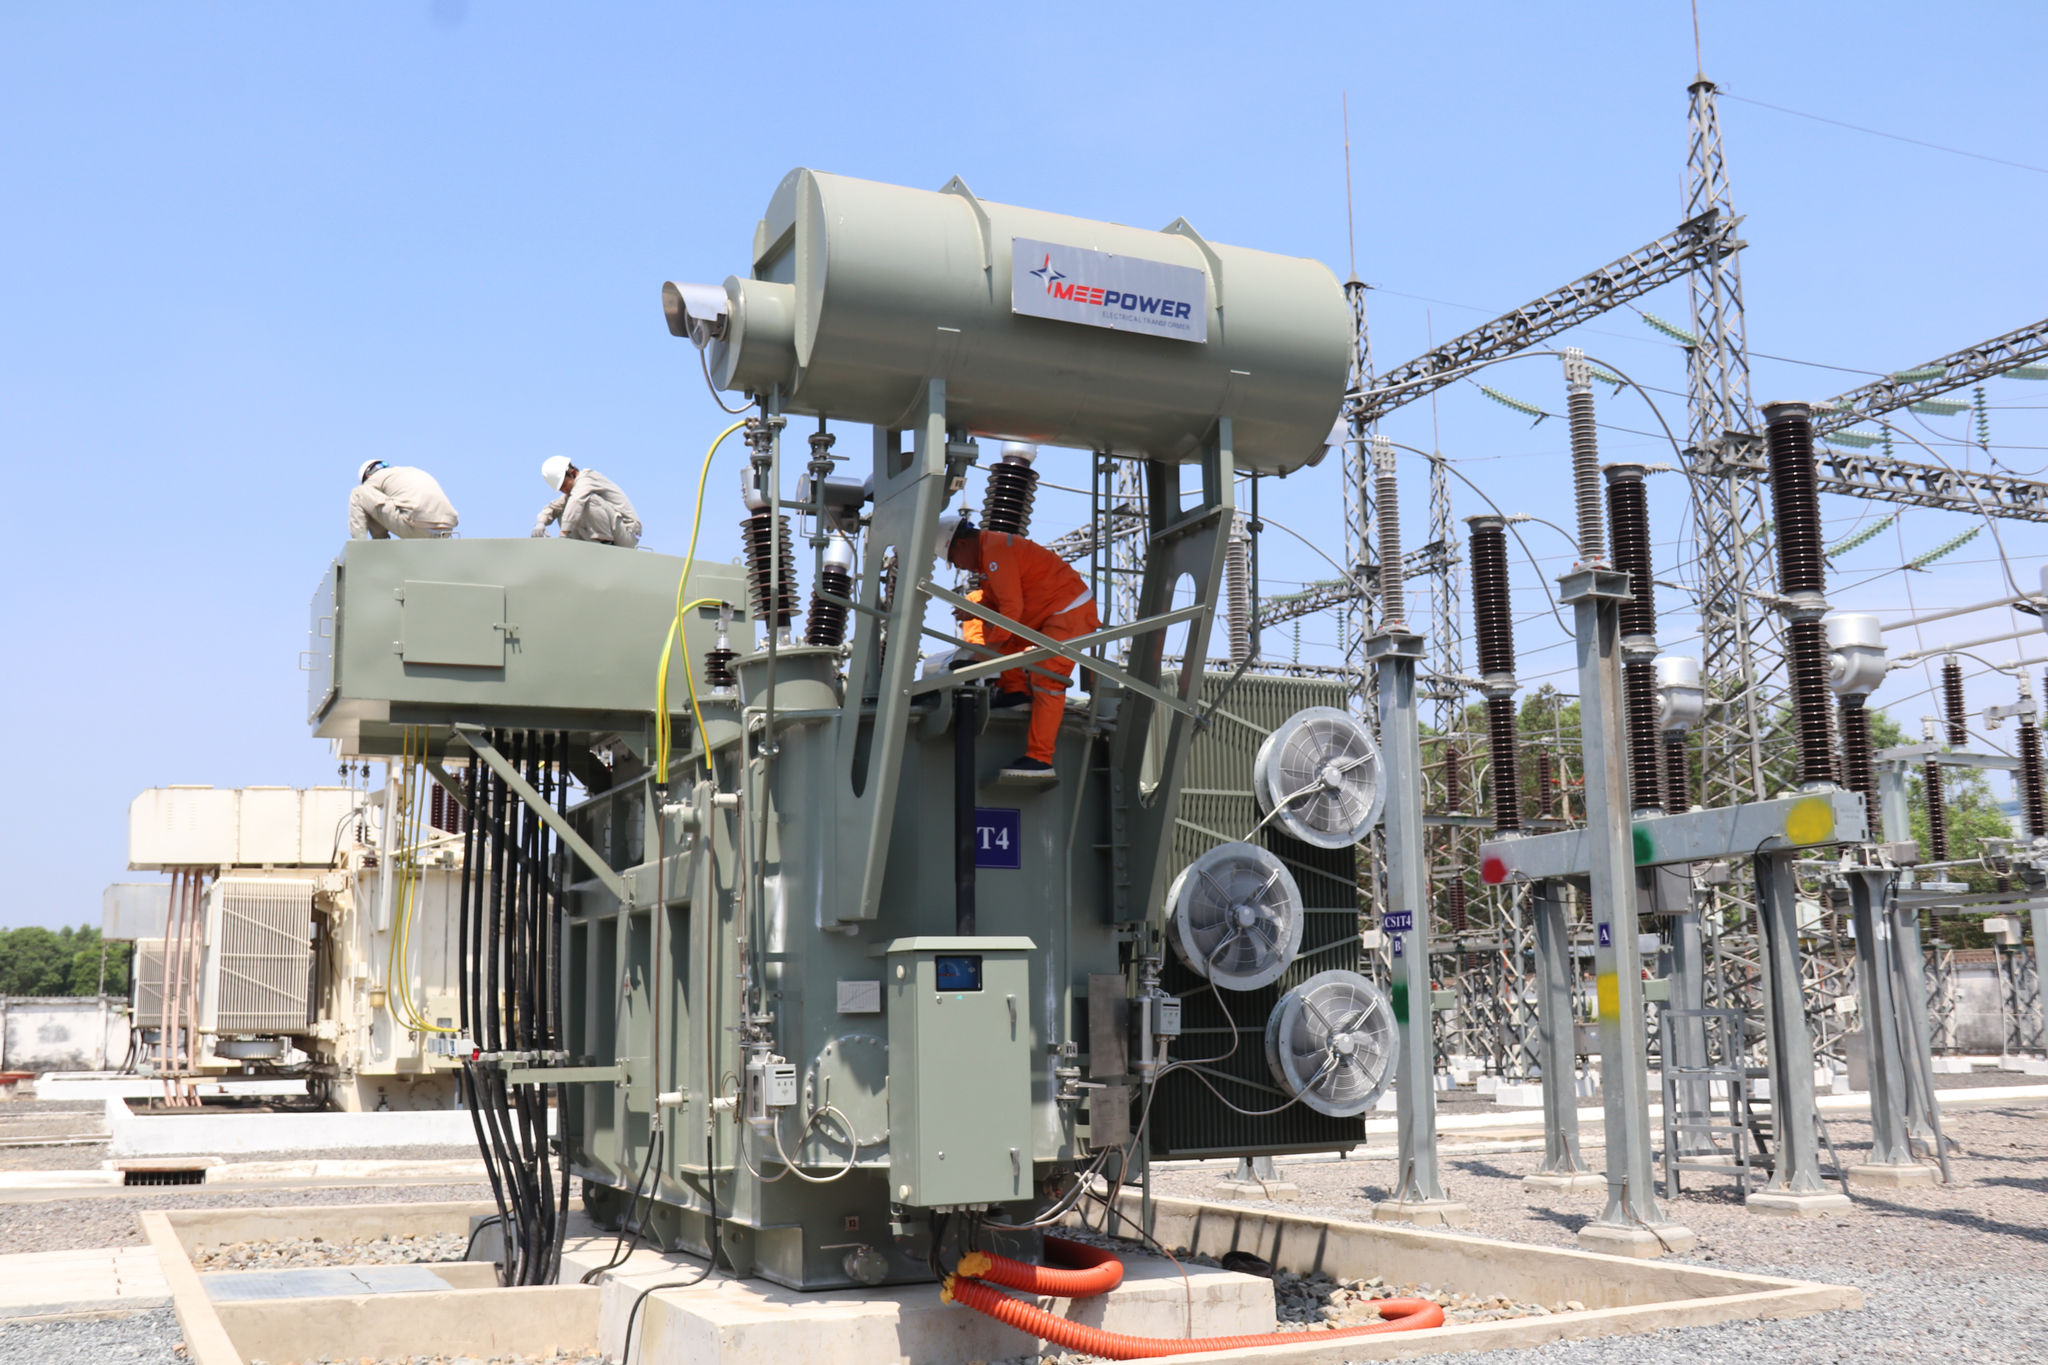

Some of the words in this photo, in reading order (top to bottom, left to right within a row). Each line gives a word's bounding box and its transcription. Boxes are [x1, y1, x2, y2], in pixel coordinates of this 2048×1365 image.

[1053, 281, 1191, 320] MEEPOWER
[1102, 310, 1142, 324] ELECTRICAL
[976, 826, 1010, 850] T4
[1600, 928, 1609, 941] A
[1394, 940, 1401, 952] B
